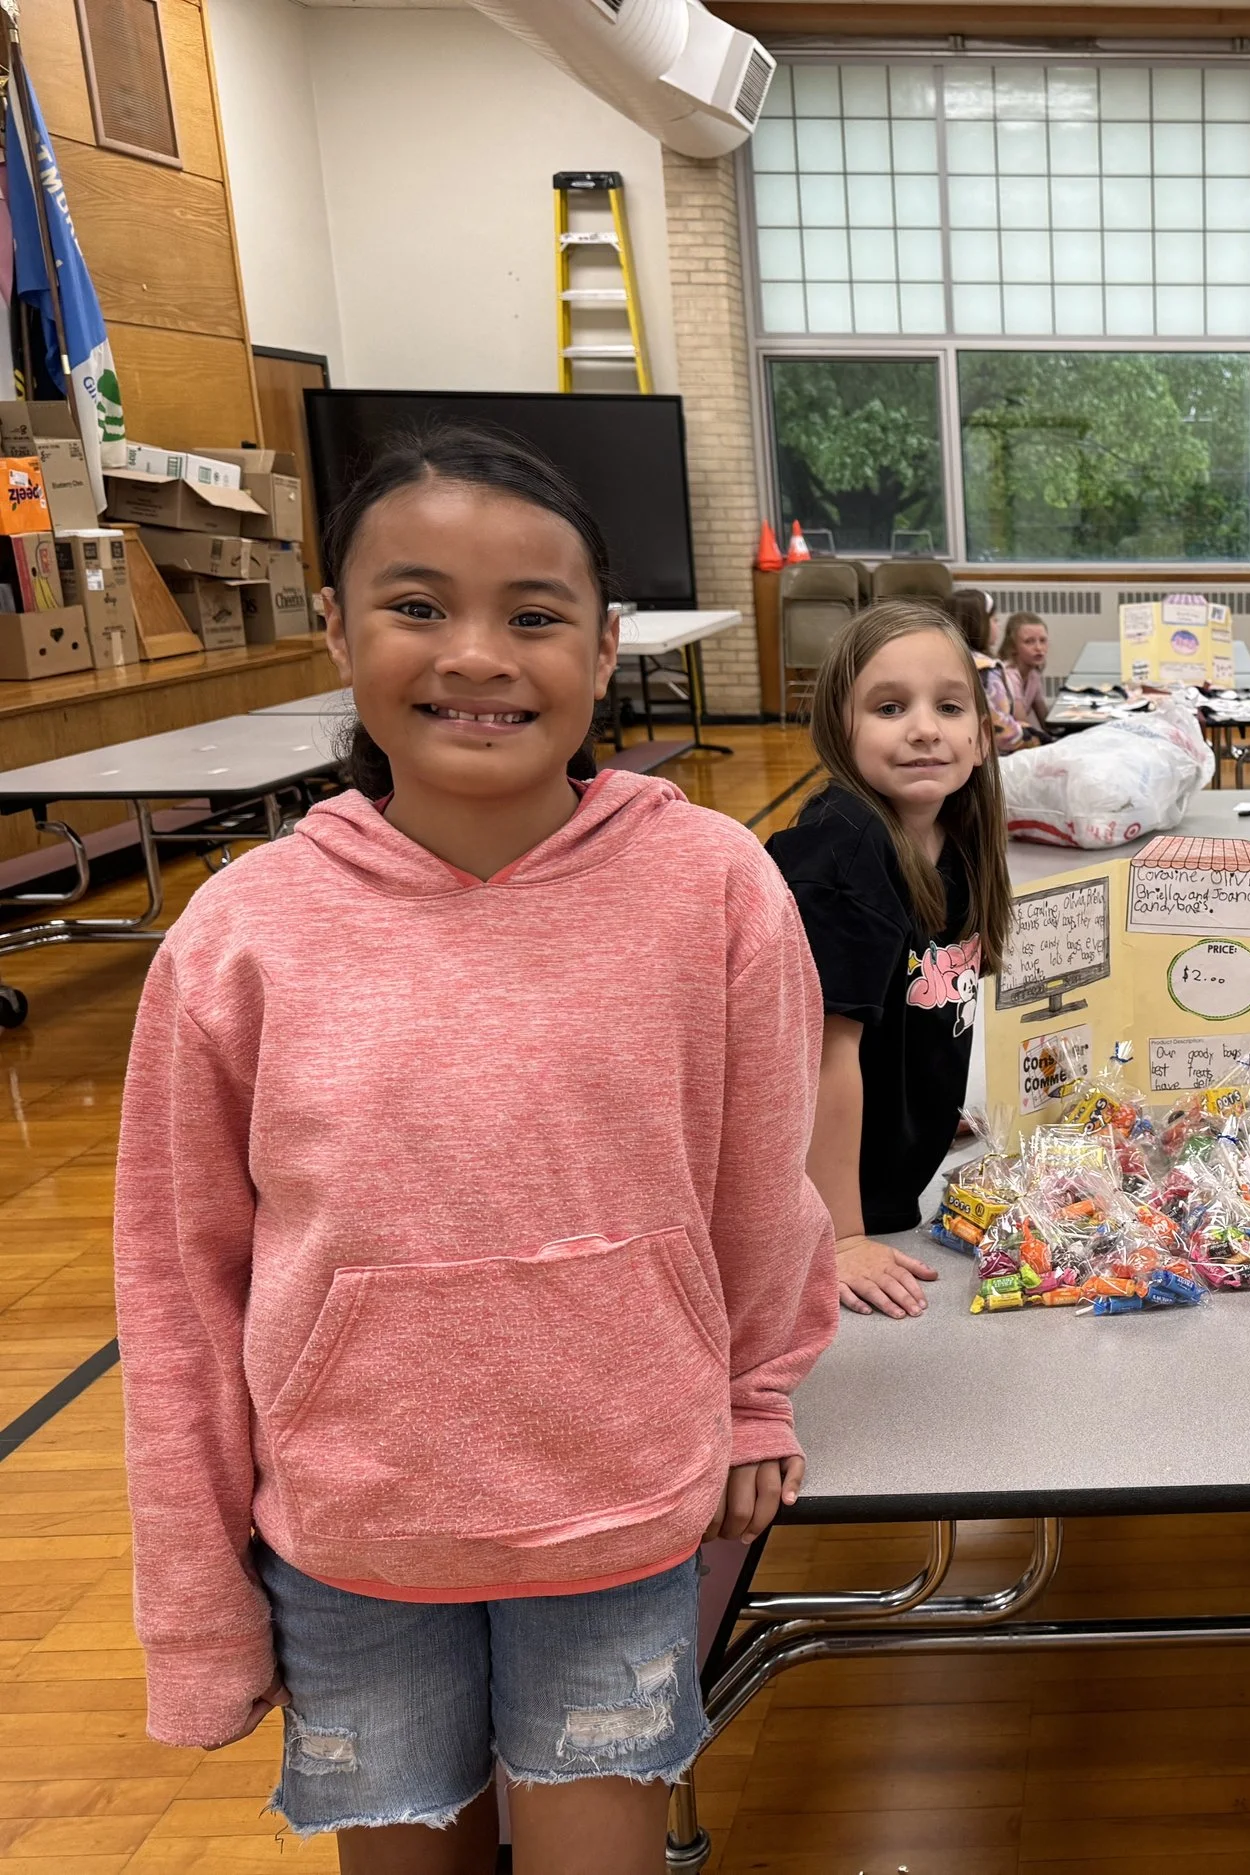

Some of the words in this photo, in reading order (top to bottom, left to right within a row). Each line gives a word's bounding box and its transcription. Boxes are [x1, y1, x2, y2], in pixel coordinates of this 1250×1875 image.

[1188, 889, 1210, 901] and
[1207, 944, 1237, 954] PRICE:
[1156, 1046, 1176, 1059] Our
[1188, 1048, 1214, 1065] goody
[1152, 1061, 1170, 1077] best
[1155, 1079, 1181, 1091] have
[1216, 1089, 1242, 1112] DOTS
[948, 1194, 971, 1214] DOTS
